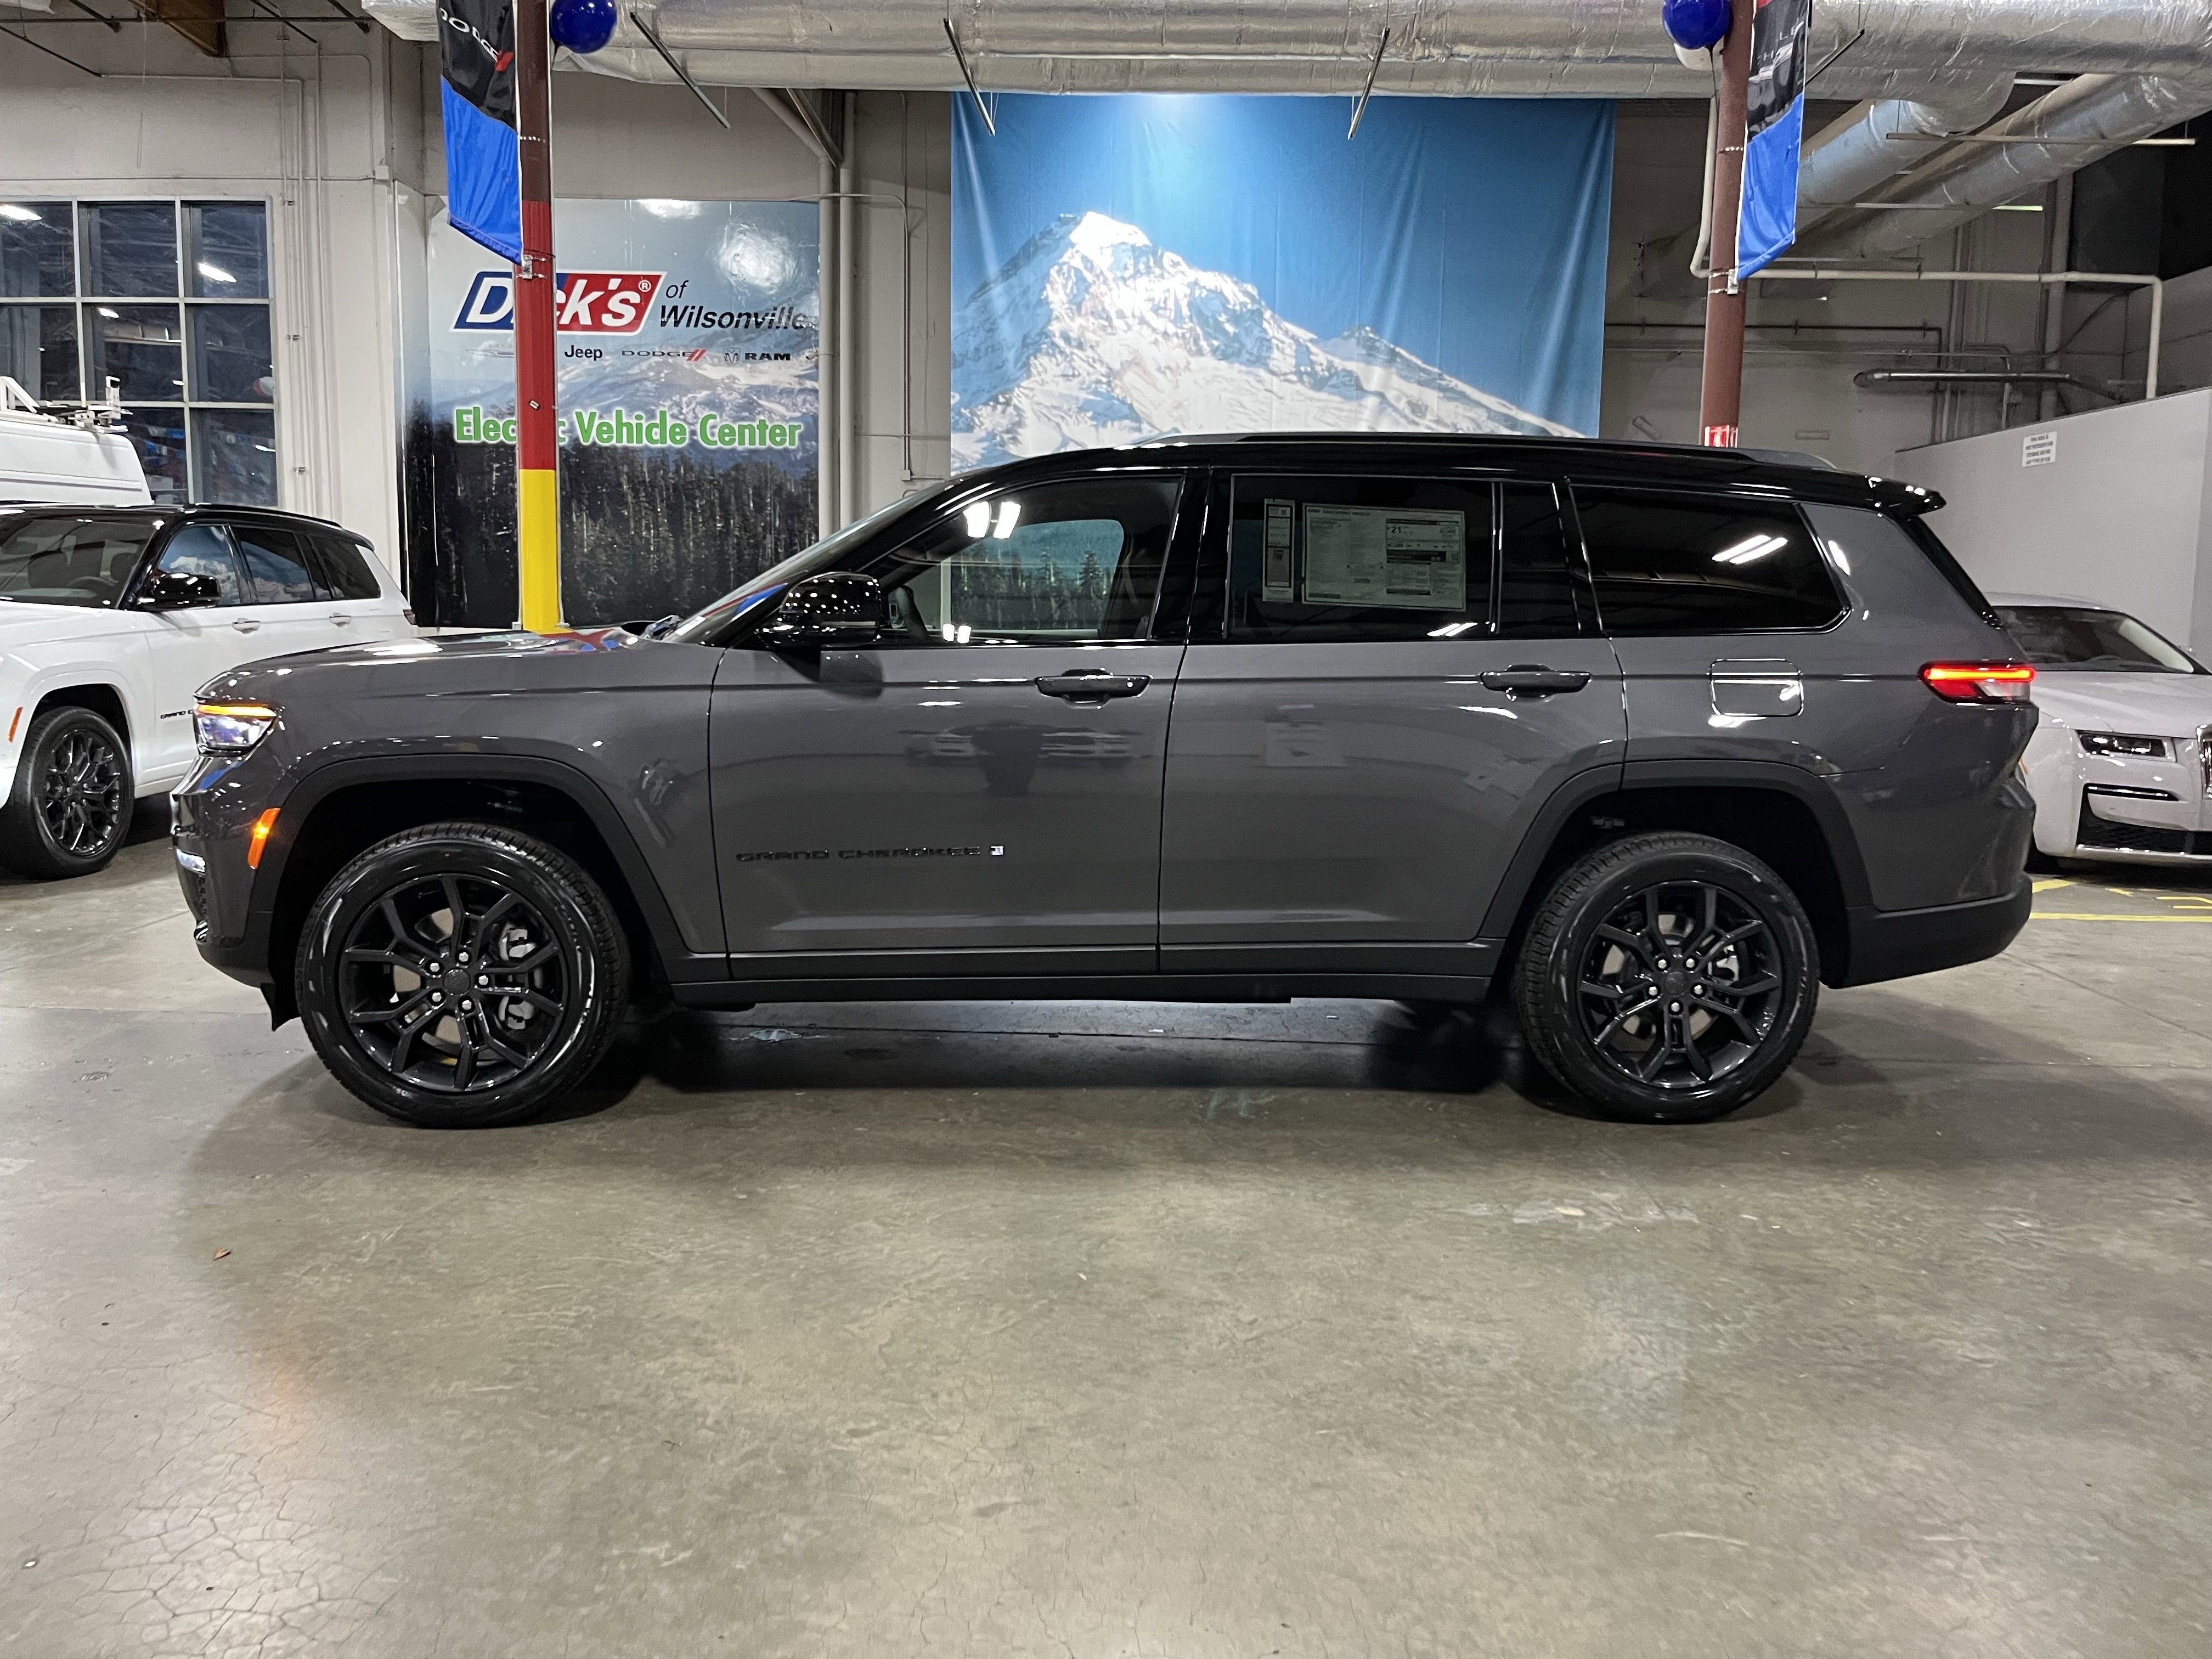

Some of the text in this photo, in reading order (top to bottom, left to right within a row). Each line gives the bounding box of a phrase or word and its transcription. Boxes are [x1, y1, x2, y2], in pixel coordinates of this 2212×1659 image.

[665, 280, 689, 298] of
[466, 277, 641, 327] Dk's
[660, 305, 807, 330] Wilsonville
[564, 345, 603, 361] Jeep
[744, 352, 791, 361] RAM
[575, 409, 687, 445] Vehicle
[699, 414, 802, 447] Center
[736, 850, 829, 861] GRAND
[838, 846, 980, 859] CHEROKEE
